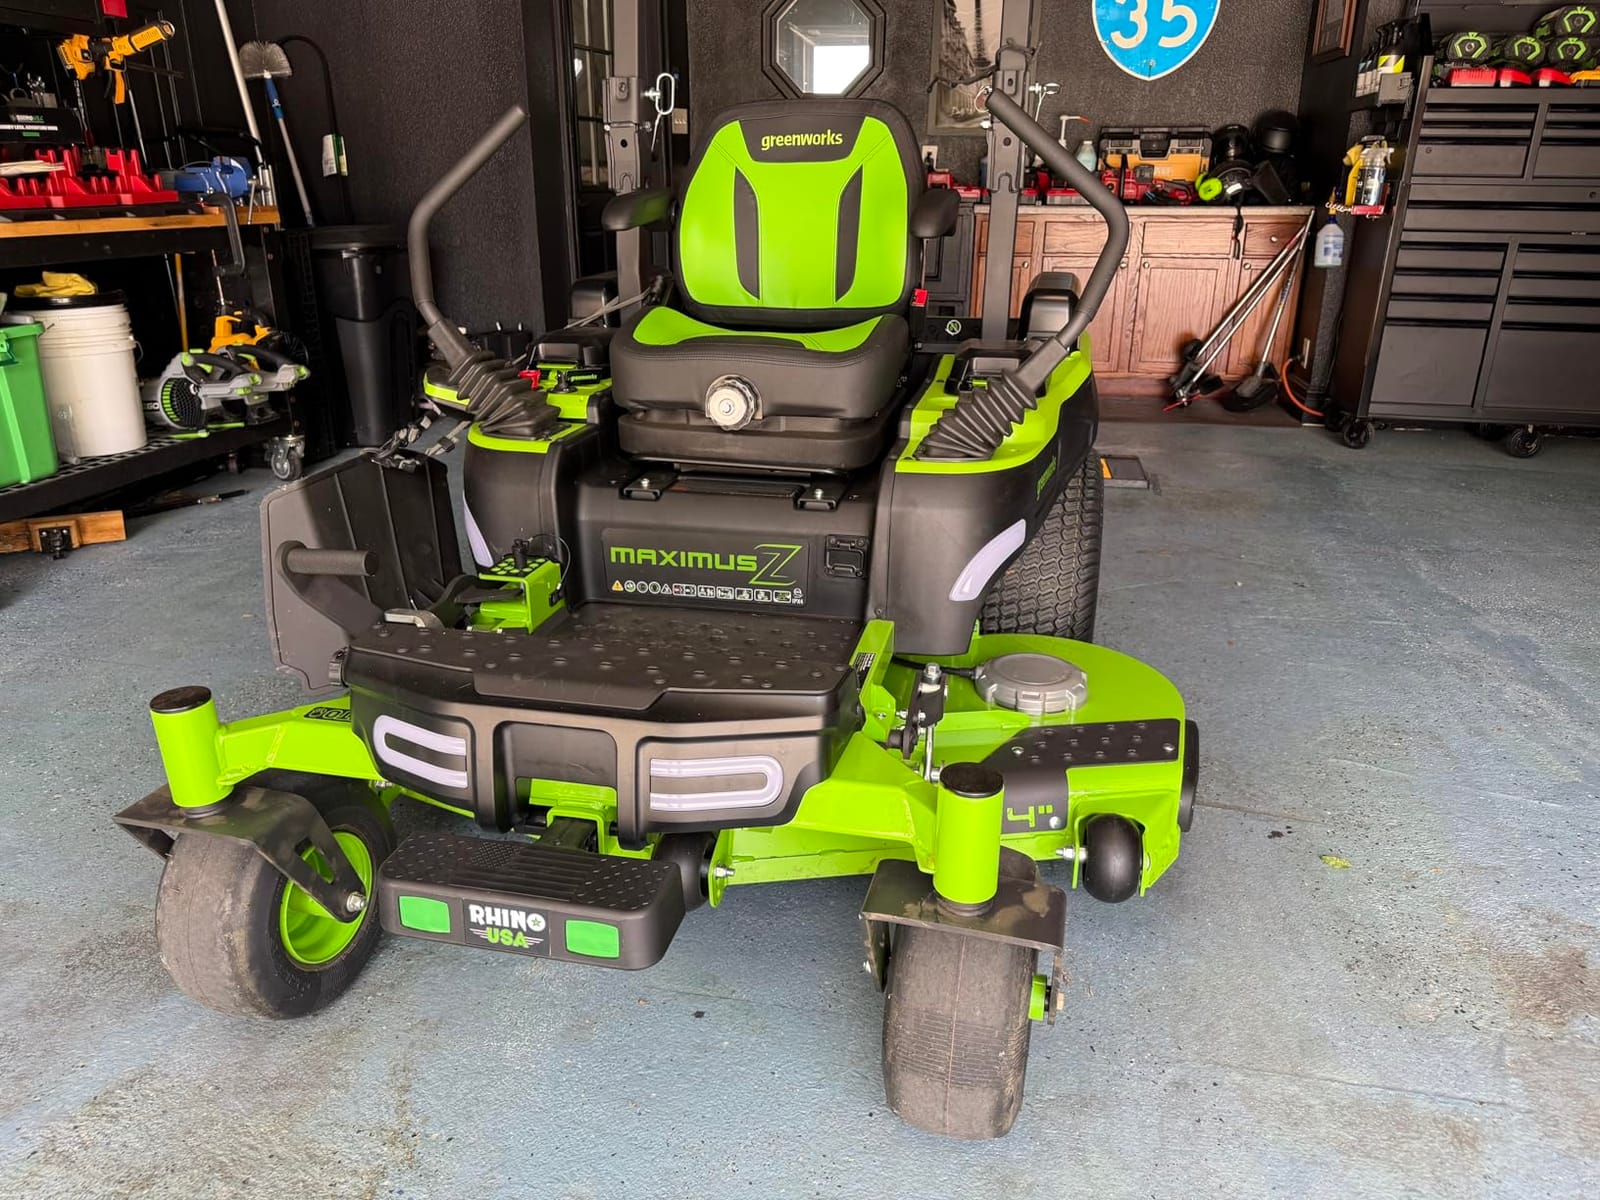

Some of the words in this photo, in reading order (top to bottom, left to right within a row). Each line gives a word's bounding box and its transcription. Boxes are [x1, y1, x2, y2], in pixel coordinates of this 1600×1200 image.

[1110, 0, 1197, 48] 35
[761, 128, 843, 151] greenworks
[610, 546, 758, 572] MAXIMUS
[468, 904, 546, 932] RHINO
[486, 926, 530, 949] USA
